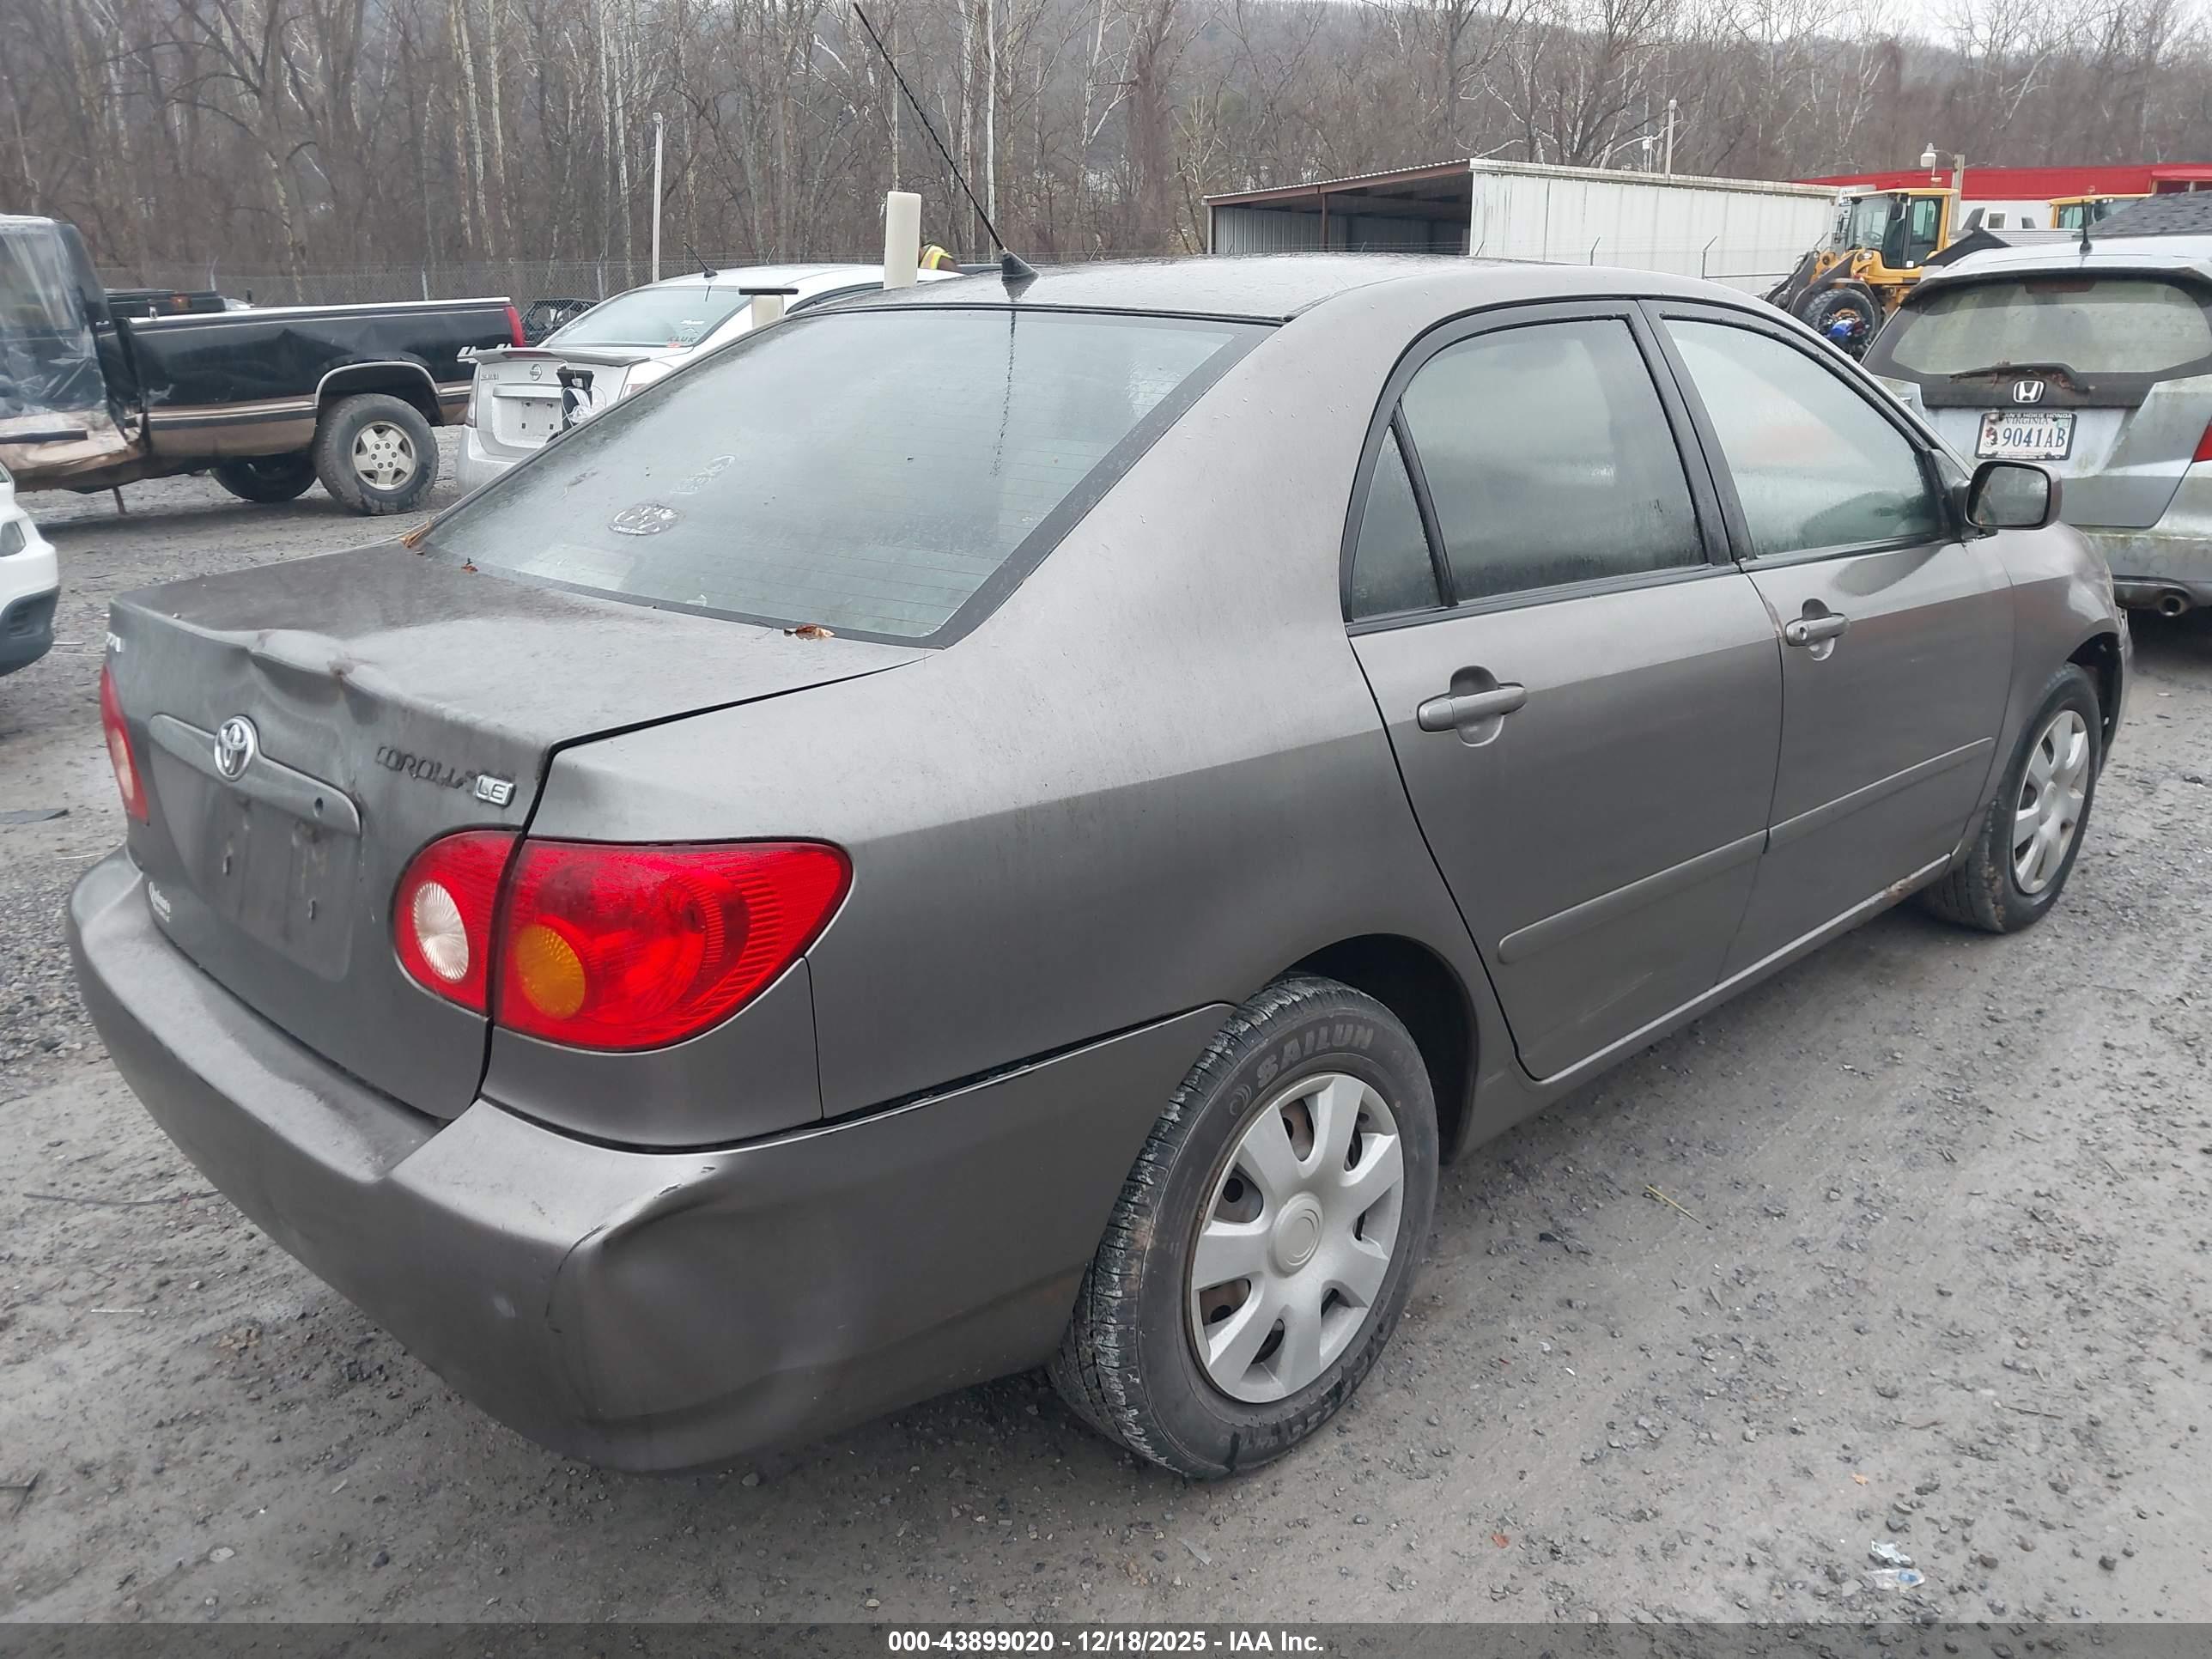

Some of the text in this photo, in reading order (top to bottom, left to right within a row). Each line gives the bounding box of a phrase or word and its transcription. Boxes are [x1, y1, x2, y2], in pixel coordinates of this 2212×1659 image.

[2001, 427, 2066, 448] 9041AB
[477, 777, 507, 800] LE
[1257, 1023, 1375, 1088] SAILUN
